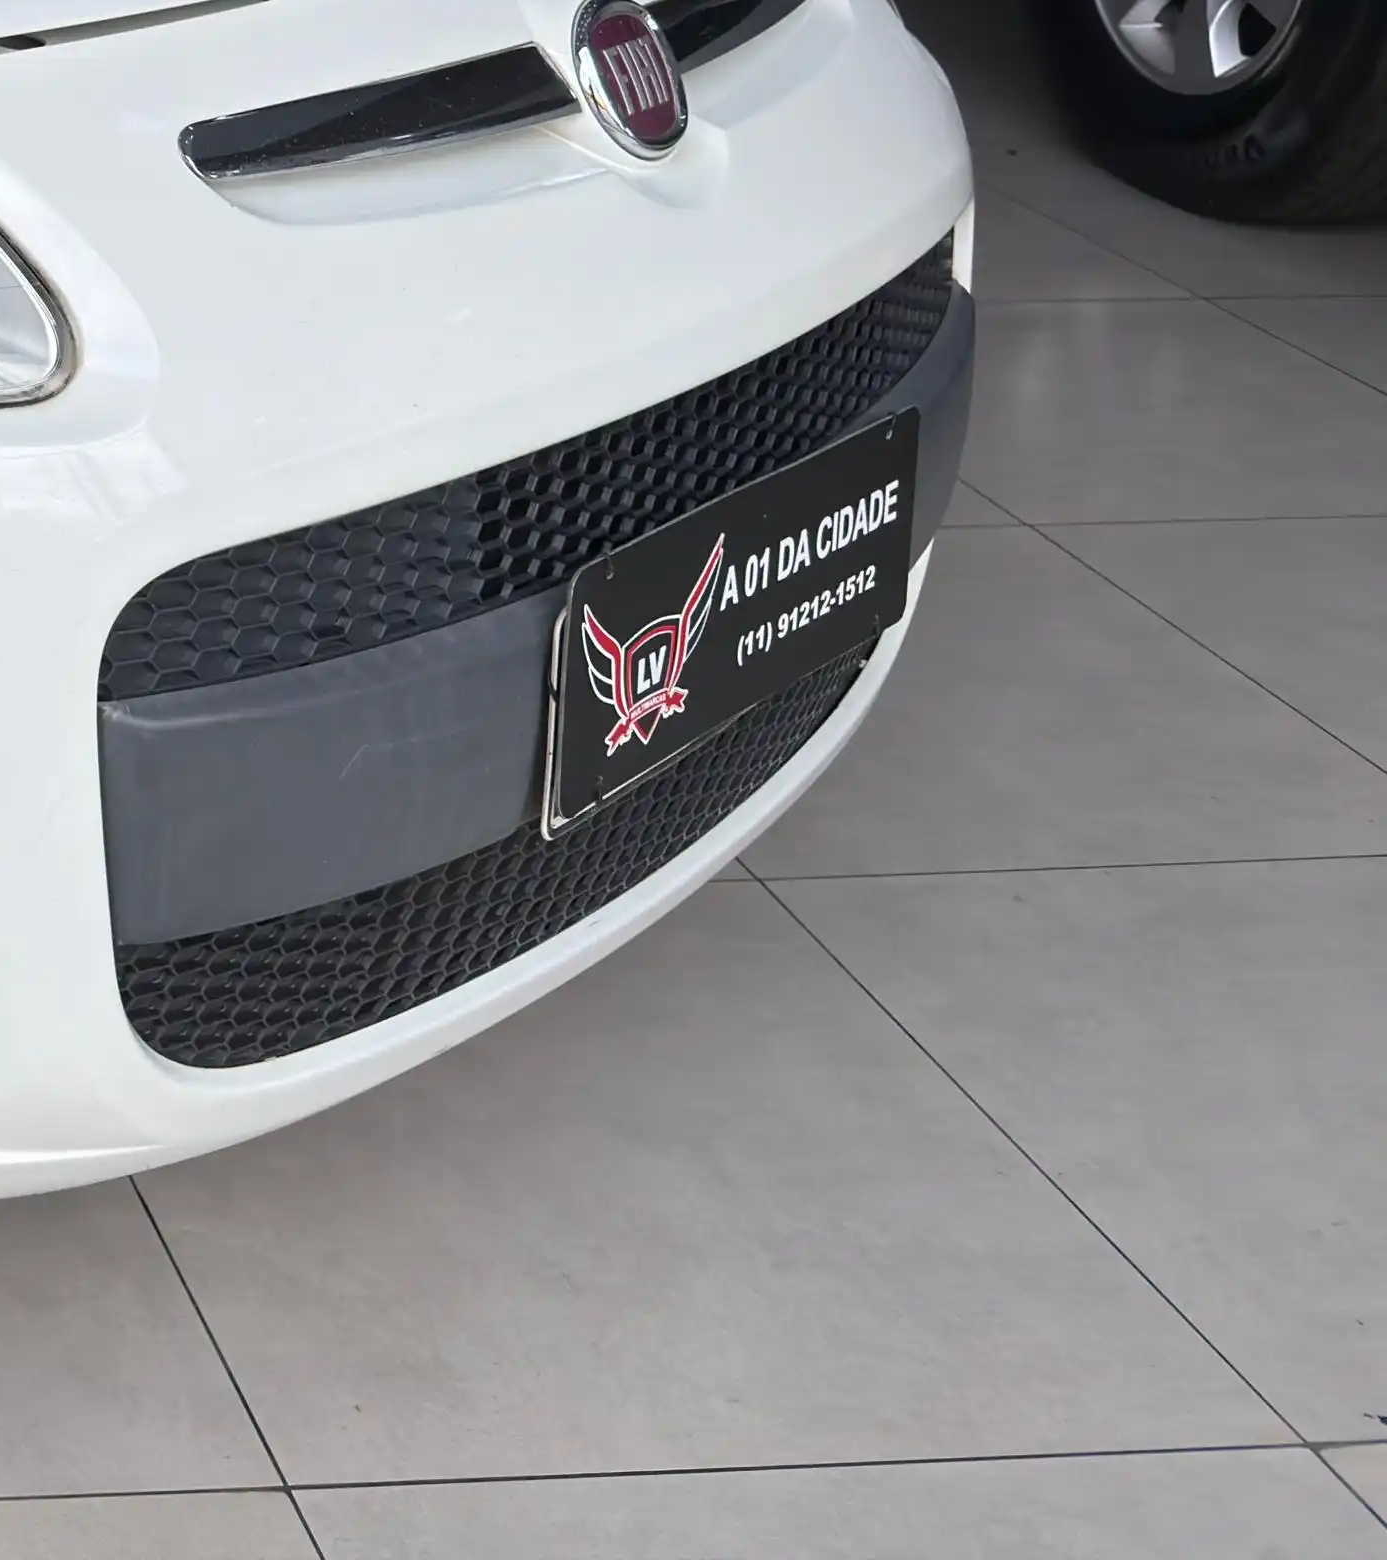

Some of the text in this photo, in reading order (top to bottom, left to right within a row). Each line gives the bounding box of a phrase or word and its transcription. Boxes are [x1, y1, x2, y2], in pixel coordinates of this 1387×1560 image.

[602, 34, 669, 117] FIAT
[720, 479, 899, 611] A 01 DA CIDADE
[737, 564, 877, 667] (11) 91212-1512
[636, 644, 667, 695] LV
